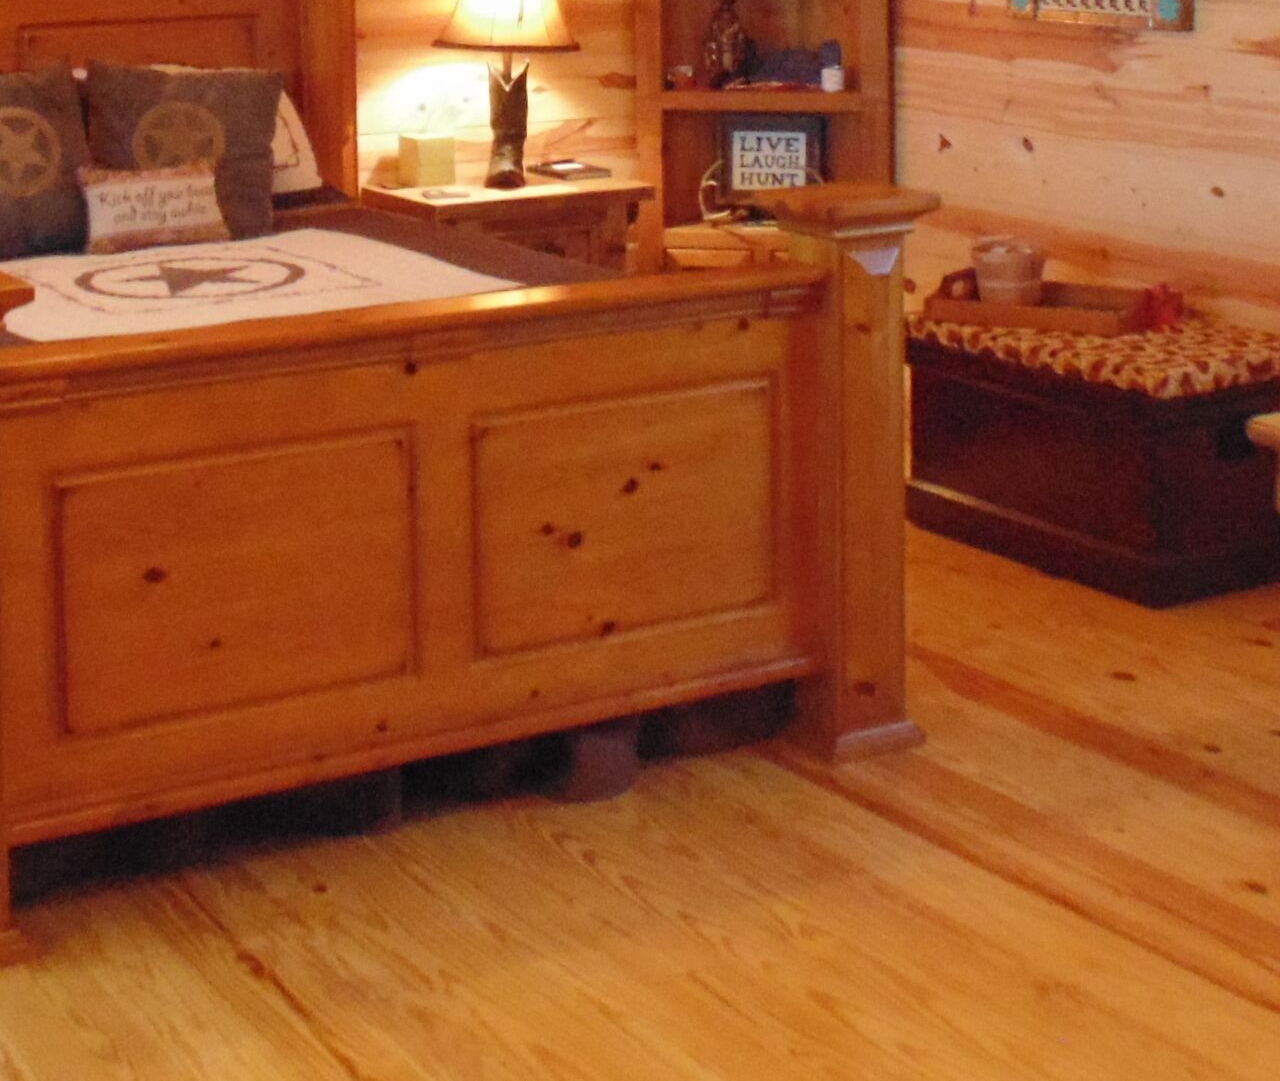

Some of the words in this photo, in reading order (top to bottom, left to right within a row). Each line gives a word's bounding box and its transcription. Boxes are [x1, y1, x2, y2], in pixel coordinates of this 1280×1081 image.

[739, 136, 800, 152] LIVE
[739, 154, 800, 169] LAUGH
[740, 172, 800, 186] HUNT
